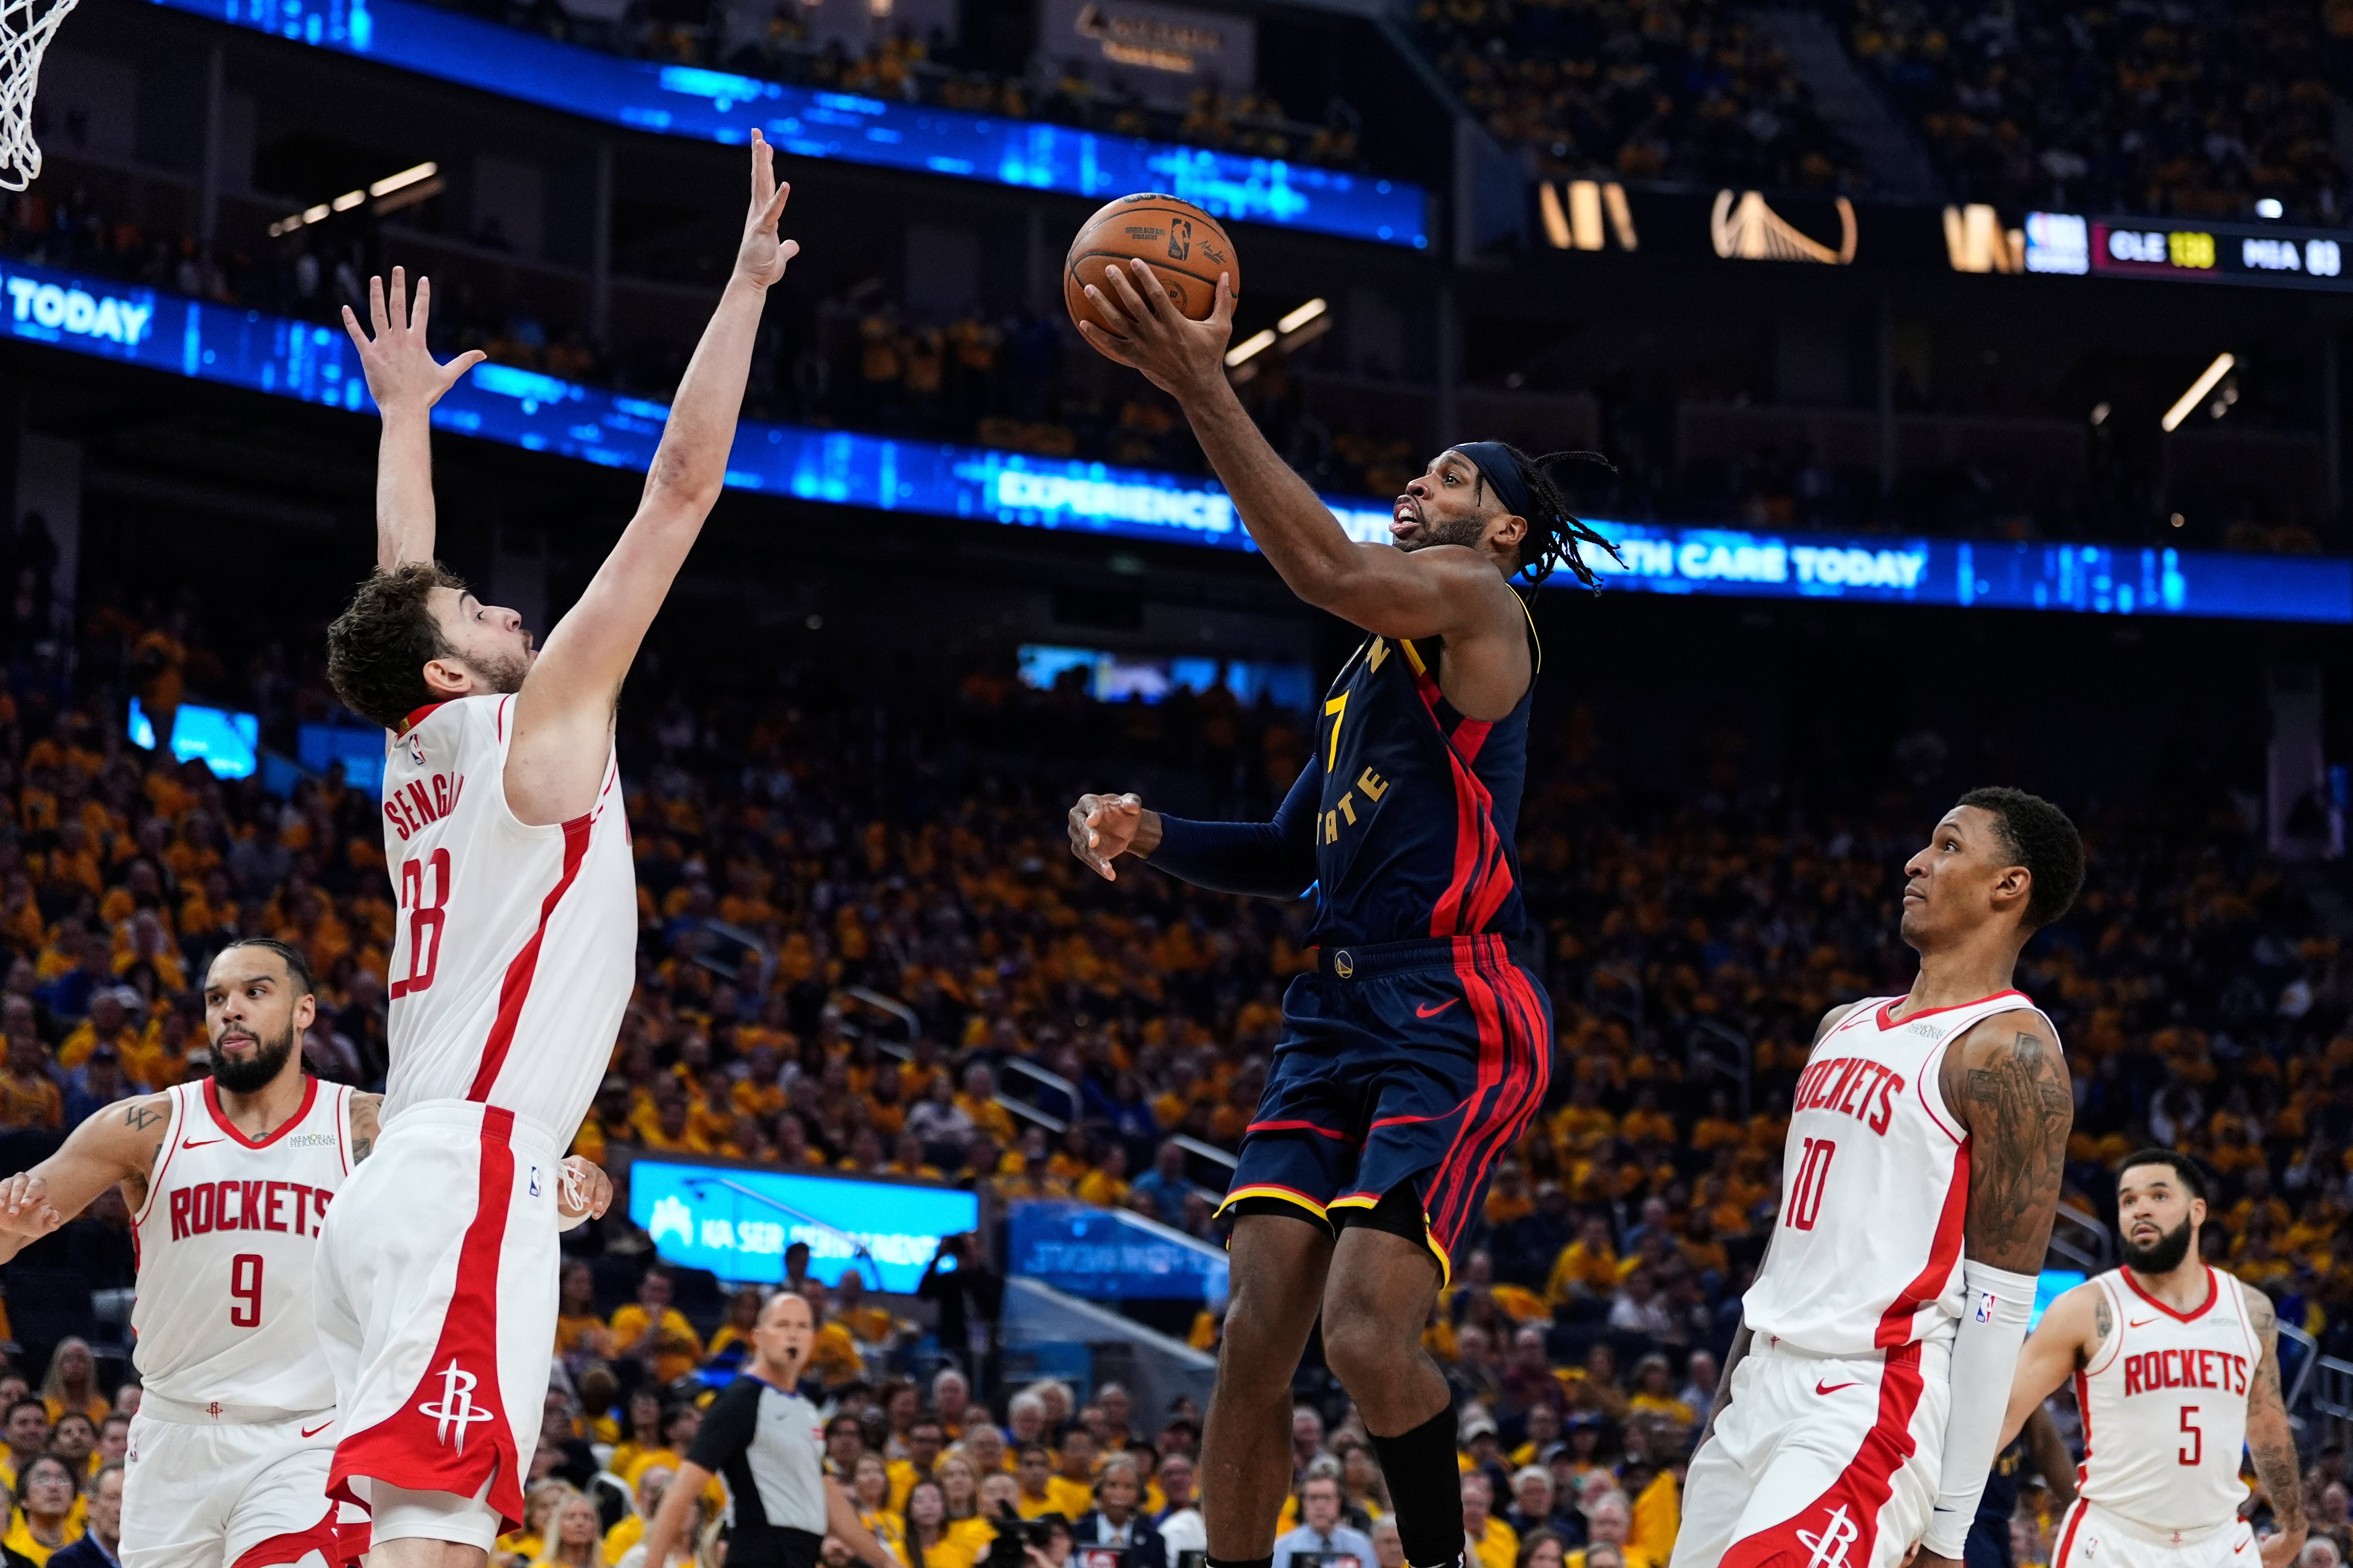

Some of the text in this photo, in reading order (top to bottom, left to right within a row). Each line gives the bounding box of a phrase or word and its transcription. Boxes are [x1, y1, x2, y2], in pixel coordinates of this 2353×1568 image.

[7, 276, 150, 345] TODAY
[998, 470, 1232, 532] EXPERIENCE
[1678, 540, 1788, 582] CARE
[1790, 545, 1925, 589] TODAY
[1326, 689, 1350, 775] 7
[290, 1134, 336, 1142] MEMORIAL
[290, 1140, 336, 1148] HERMANN
[1785, 1137, 1836, 1231] 10
[231, 1254, 263, 1328] 9
[2124, 1349, 2246, 1398] ROCKETS
[2179, 1406, 2201, 1466] 5
